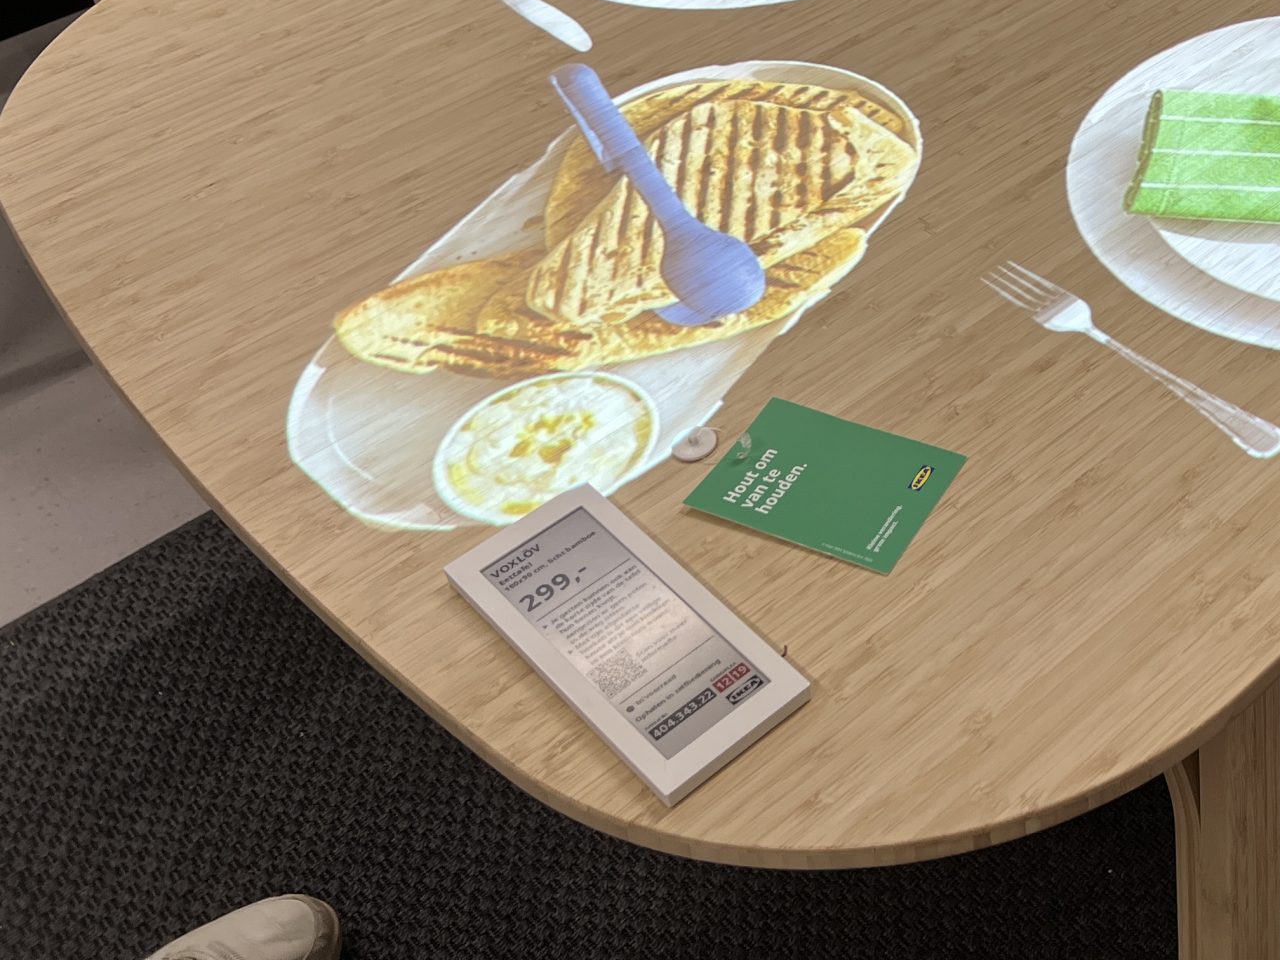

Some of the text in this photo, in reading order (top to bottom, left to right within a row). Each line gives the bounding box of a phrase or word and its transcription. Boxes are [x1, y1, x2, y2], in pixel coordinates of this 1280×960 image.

[722, 448, 778, 503] Hout om
[740, 469, 782, 508] van te
[754, 463, 808, 515] houden.
[908, 465, 933, 491] IKEA
[489, 543, 540, 578] VOXLÖV
[498, 561, 533, 586] Eettafel
[518, 566, 587, 613] 299,-
[653, 690, 714, 738] 404.343.22
[716, 677, 733, 689] 12
[731, 665, 747, 678] 19
[727, 676, 761, 703] IKEA
